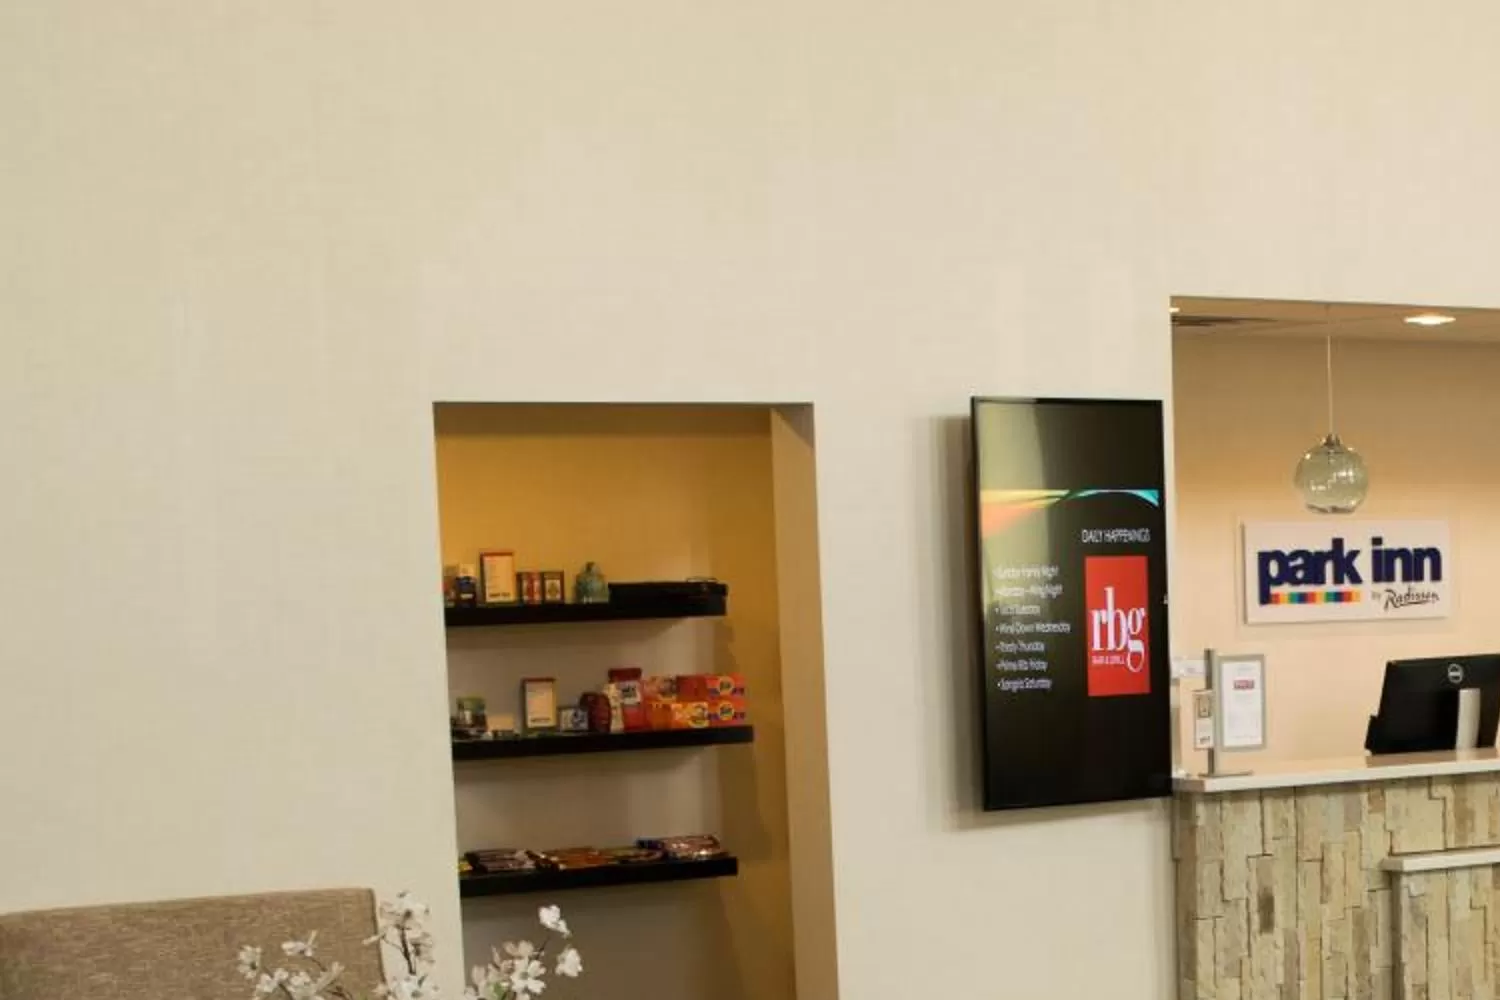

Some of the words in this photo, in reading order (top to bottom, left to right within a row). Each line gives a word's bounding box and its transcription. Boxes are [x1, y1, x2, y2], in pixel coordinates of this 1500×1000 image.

[1257, 537, 1362, 606] park
[1371, 536, 1442, 583] inn
[1384, 584, 1440, 611] Radisson
[1089, 586, 1146, 673] rbg
